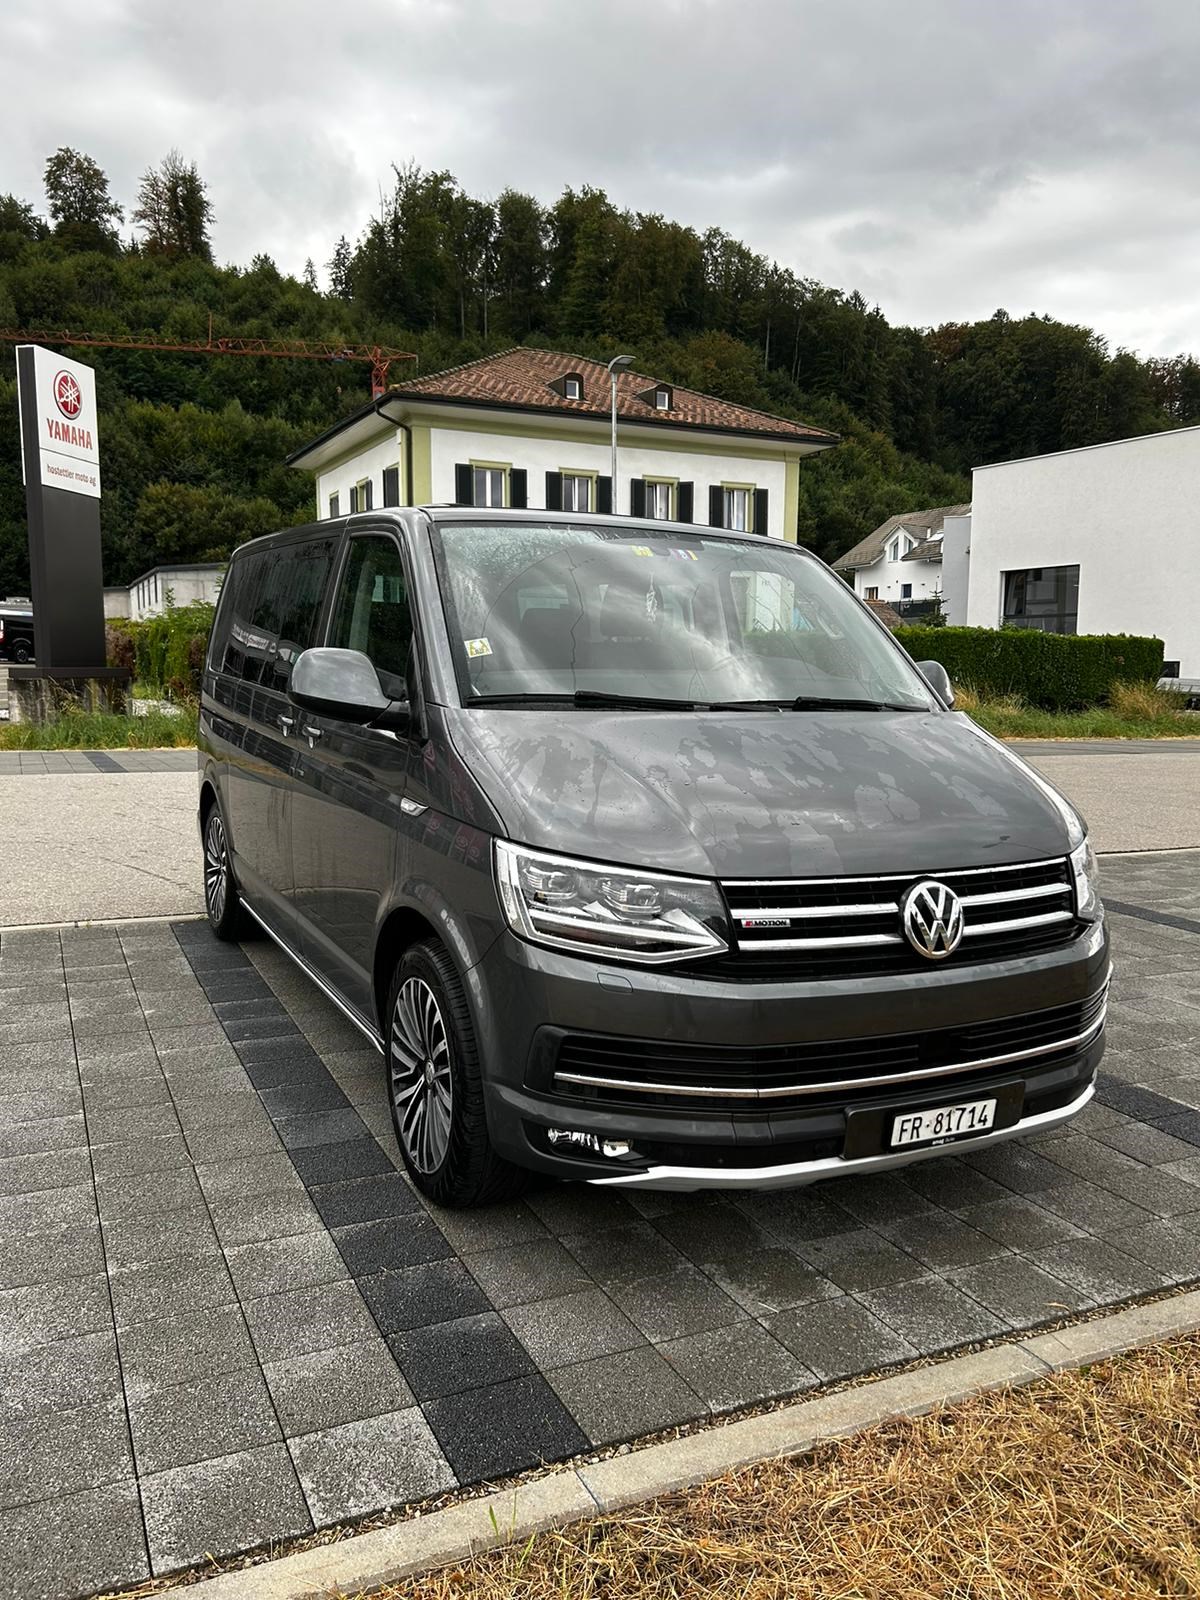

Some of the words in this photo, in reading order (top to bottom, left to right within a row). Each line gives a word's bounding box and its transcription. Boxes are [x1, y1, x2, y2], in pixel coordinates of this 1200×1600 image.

[46, 417, 93, 450] YAMAHA
[47, 463, 75, 480] hostettler
[75, 472, 89, 483] moto
[89, 476, 97, 487] ag
[904, 881, 964, 958] VW
